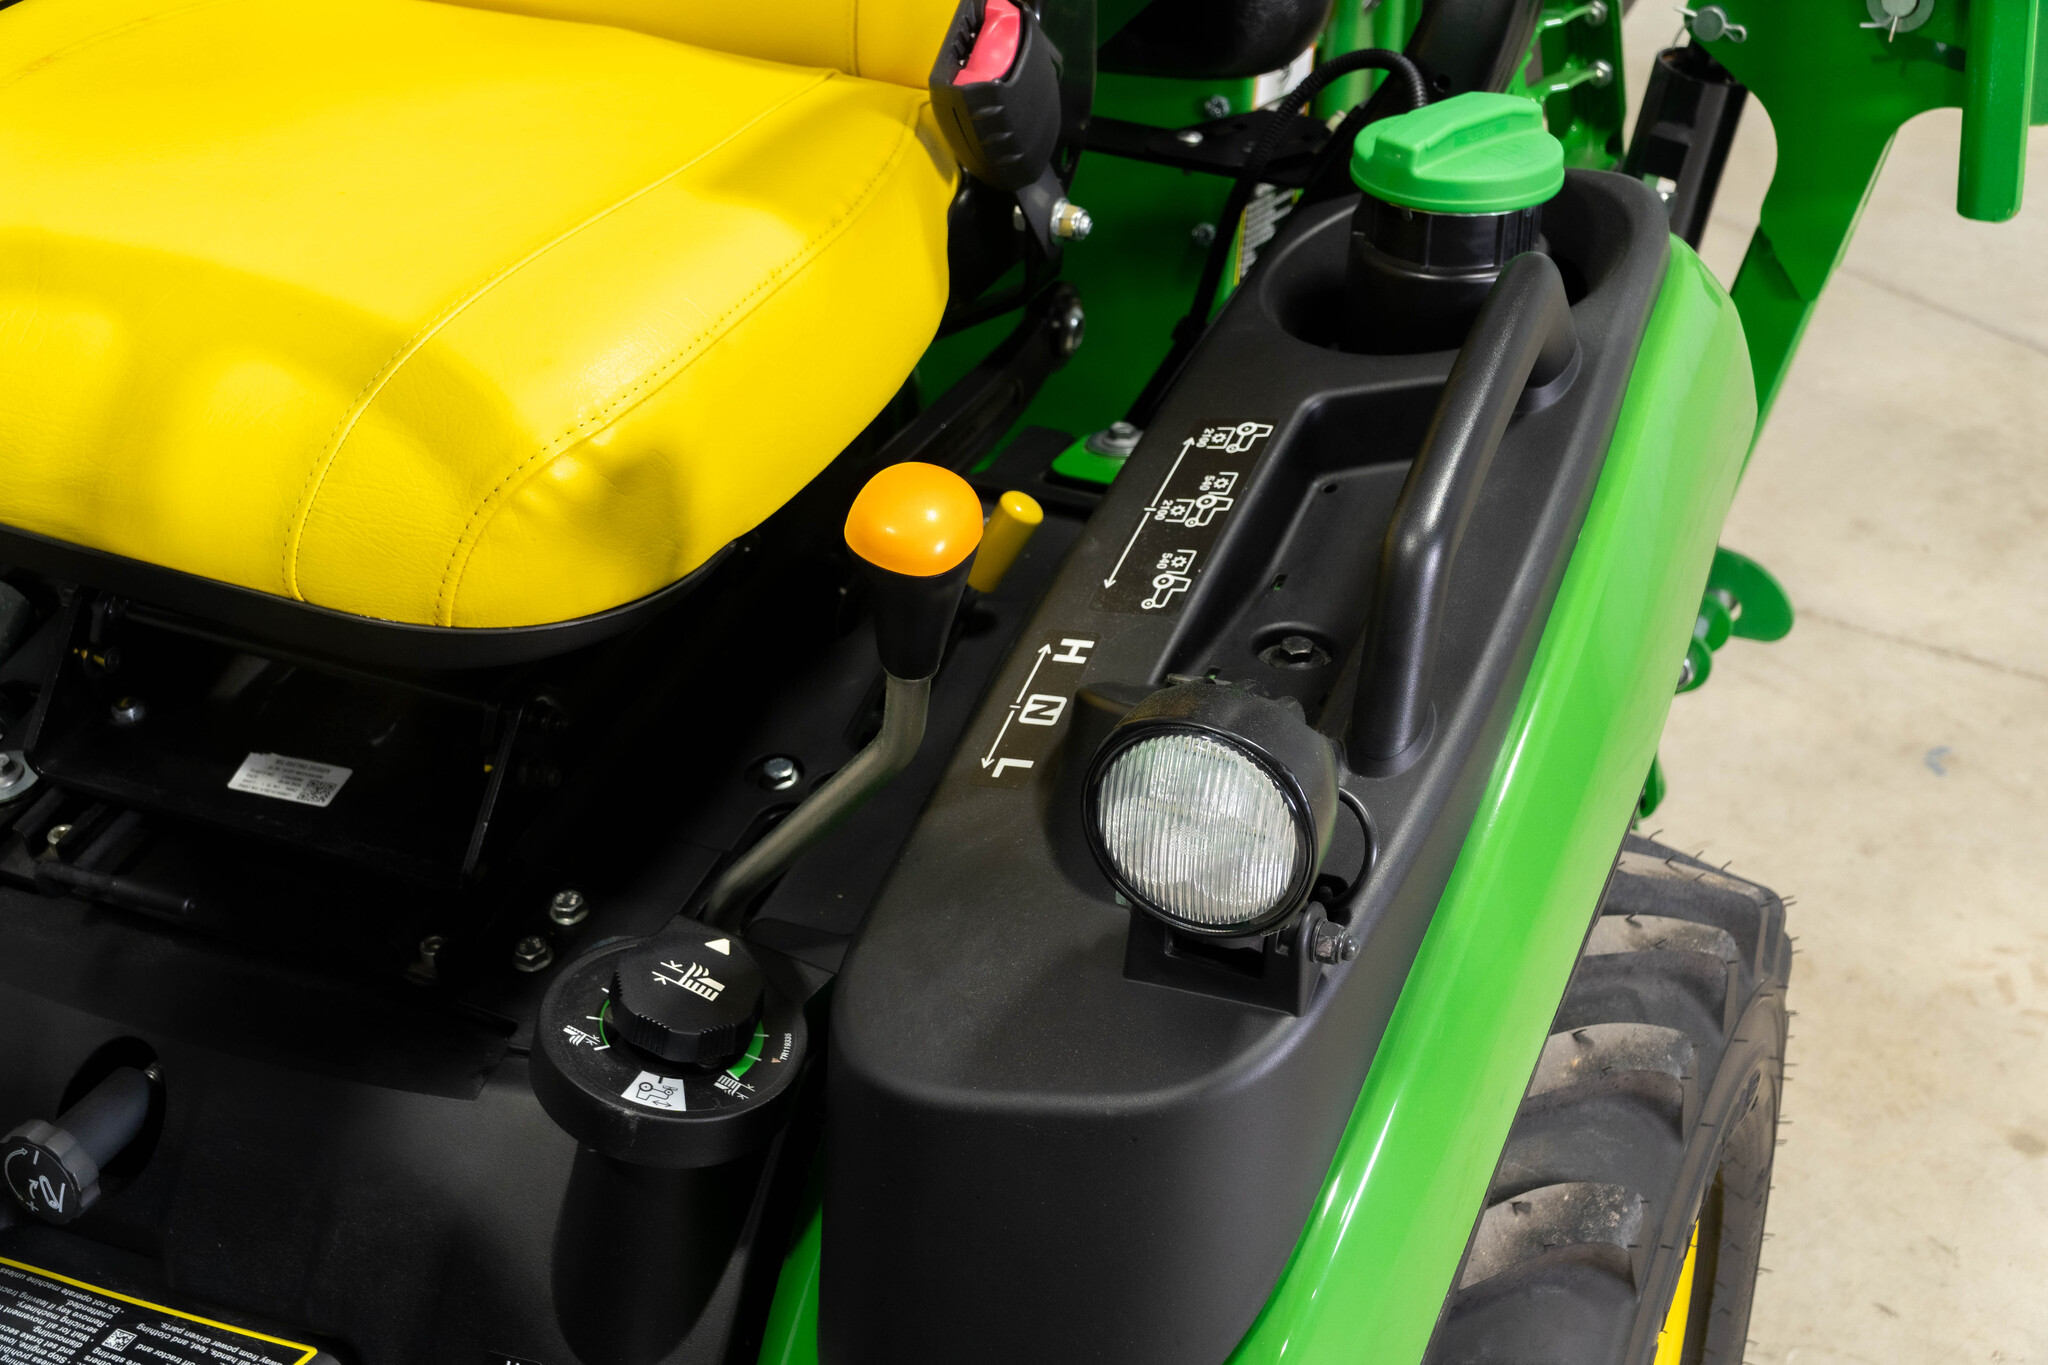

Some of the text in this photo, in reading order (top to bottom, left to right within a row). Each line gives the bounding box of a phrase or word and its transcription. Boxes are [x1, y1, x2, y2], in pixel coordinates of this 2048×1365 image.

[1196, 428, 1215, 448] 2100
[1199, 475, 1216, 491] 540
[1154, 499, 1173, 521] 2100
[1156, 553, 1173, 569] 540
[1052, 638, 1095, 664] H
[992, 757, 1034, 778] L
[779, 1033, 792, 1060] TR119335
[0, 1267, 121, 1314] Do not operate machine unless
[18, 1292, 49, 1308] leaving
[3, 1307, 47, 1325] movement
[16, 1301, 99, 1334] servicing machinery.
[55, 1305, 72, 1316] key
[65, 1299, 113, 1320] unattended.
[72, 1311, 106, 1328] Remove
[57, 1326, 71, 1335] for
[70, 1330, 90, 1342] Wait
[136, 1323, 171, 1339] clothing
[161, 1322, 186, 1334] parts.
[19, 1332, 44, 1346] brake
[32, 1325, 83, 1348] dismounting.
[43, 1340, 59, 1349] set
[170, 1336, 189, 1345] and
[184, 1331, 211, 1344] driven
[19, 1340, 48, 1355] engine,
[56, 1346, 76, 1355] and
[135, 1343, 154, 1353] and
[210, 1340, 240, 1353] power
[47, 1351, 68, 1364] Stop
[92, 1347, 126, 1363] starting
[153, 1350, 183, 1364] tractor
[210, 1348, 239, 1364] hands,
[238, 1350, 260, 1362] from
